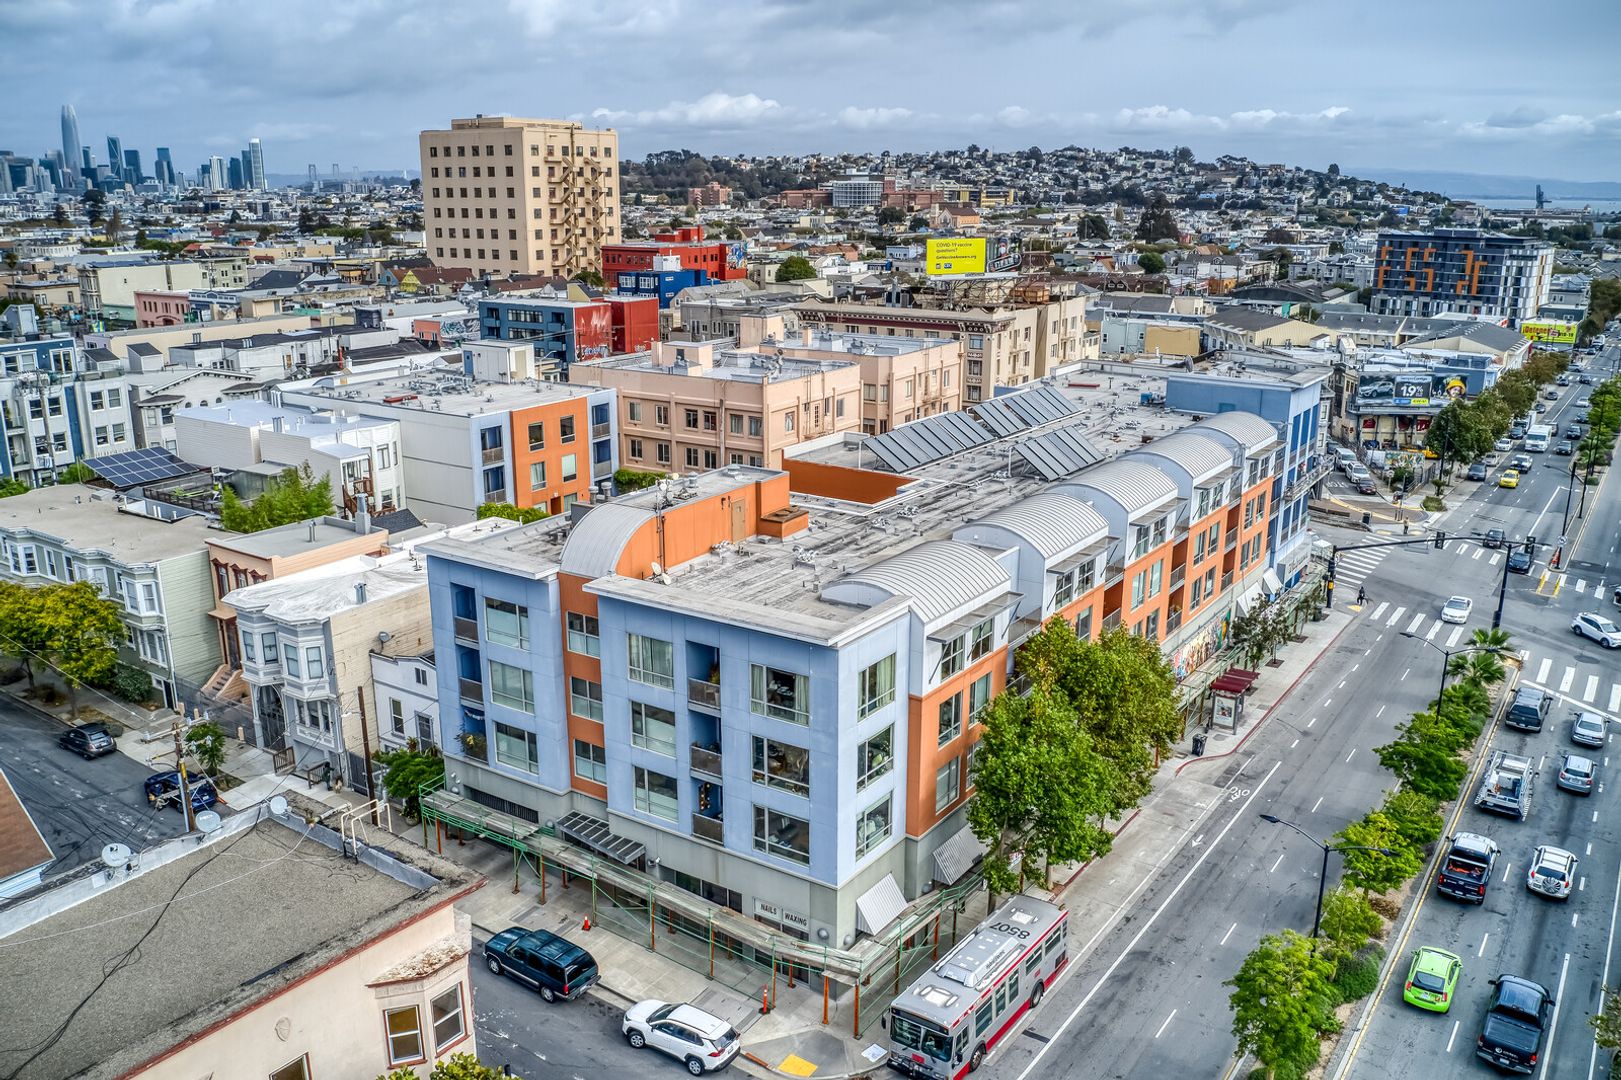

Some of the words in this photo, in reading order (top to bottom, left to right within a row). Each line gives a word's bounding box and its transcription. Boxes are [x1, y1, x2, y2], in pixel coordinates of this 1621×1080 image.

[760, 903, 777, 915] NAILS
[784, 912, 808, 926] WAXING
[989, 922, 1030, 939] 8507
